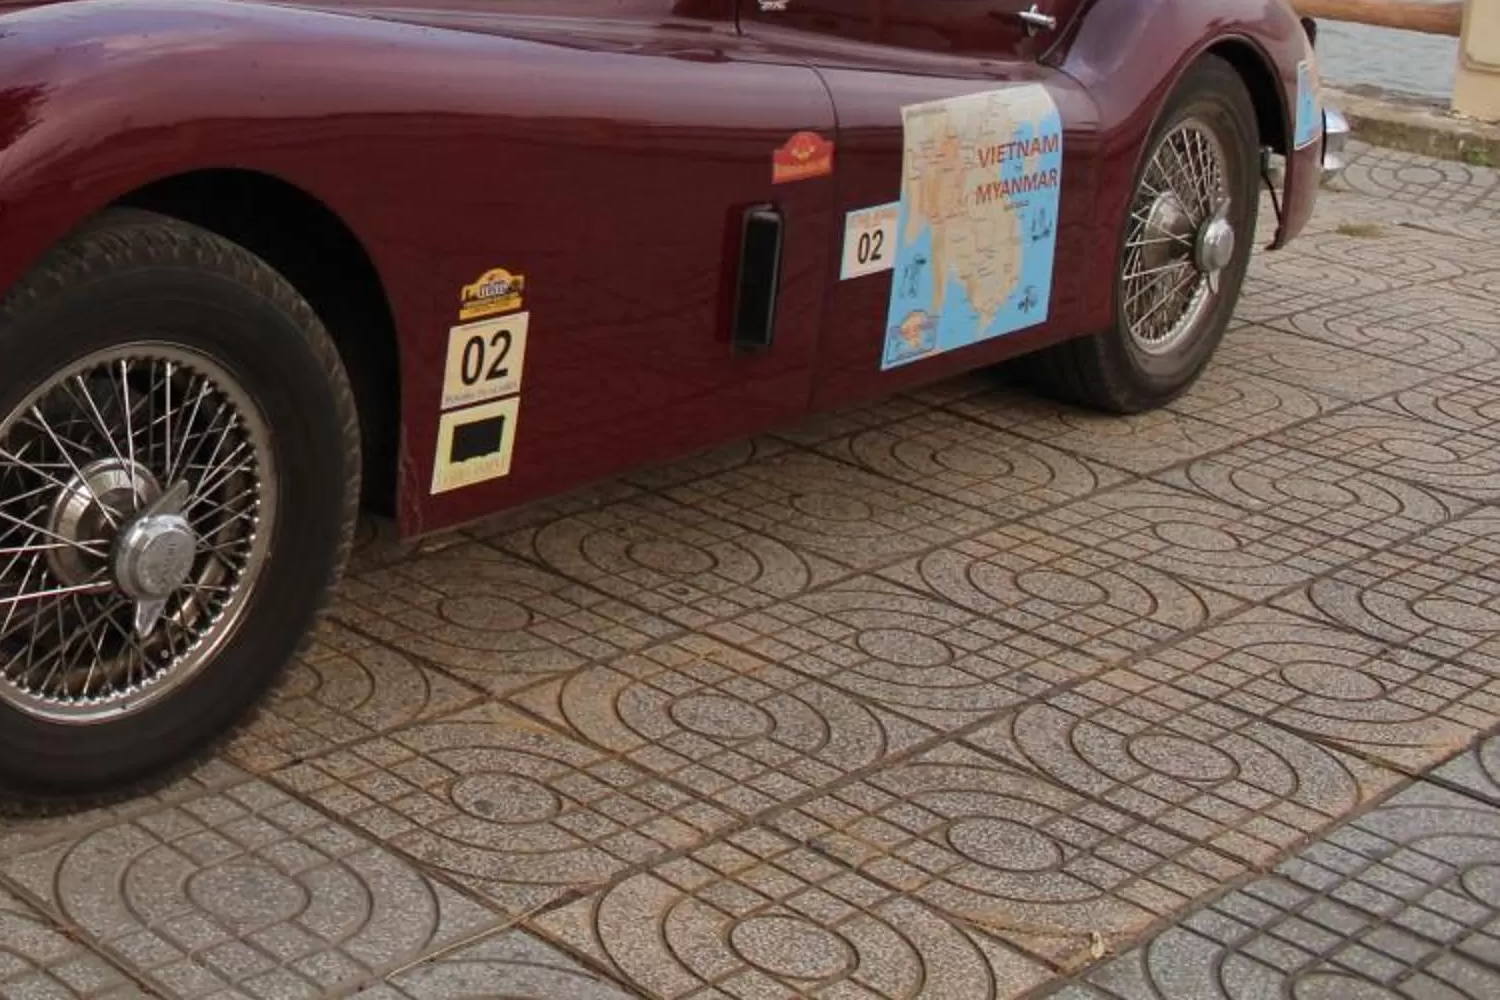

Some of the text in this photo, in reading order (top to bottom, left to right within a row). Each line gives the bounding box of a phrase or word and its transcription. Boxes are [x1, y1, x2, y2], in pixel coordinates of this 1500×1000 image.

[977, 132, 1059, 168] VIETNAM
[975, 168, 1058, 206] MYANMAR
[857, 229, 884, 264] 02
[461, 329, 512, 386] 02
